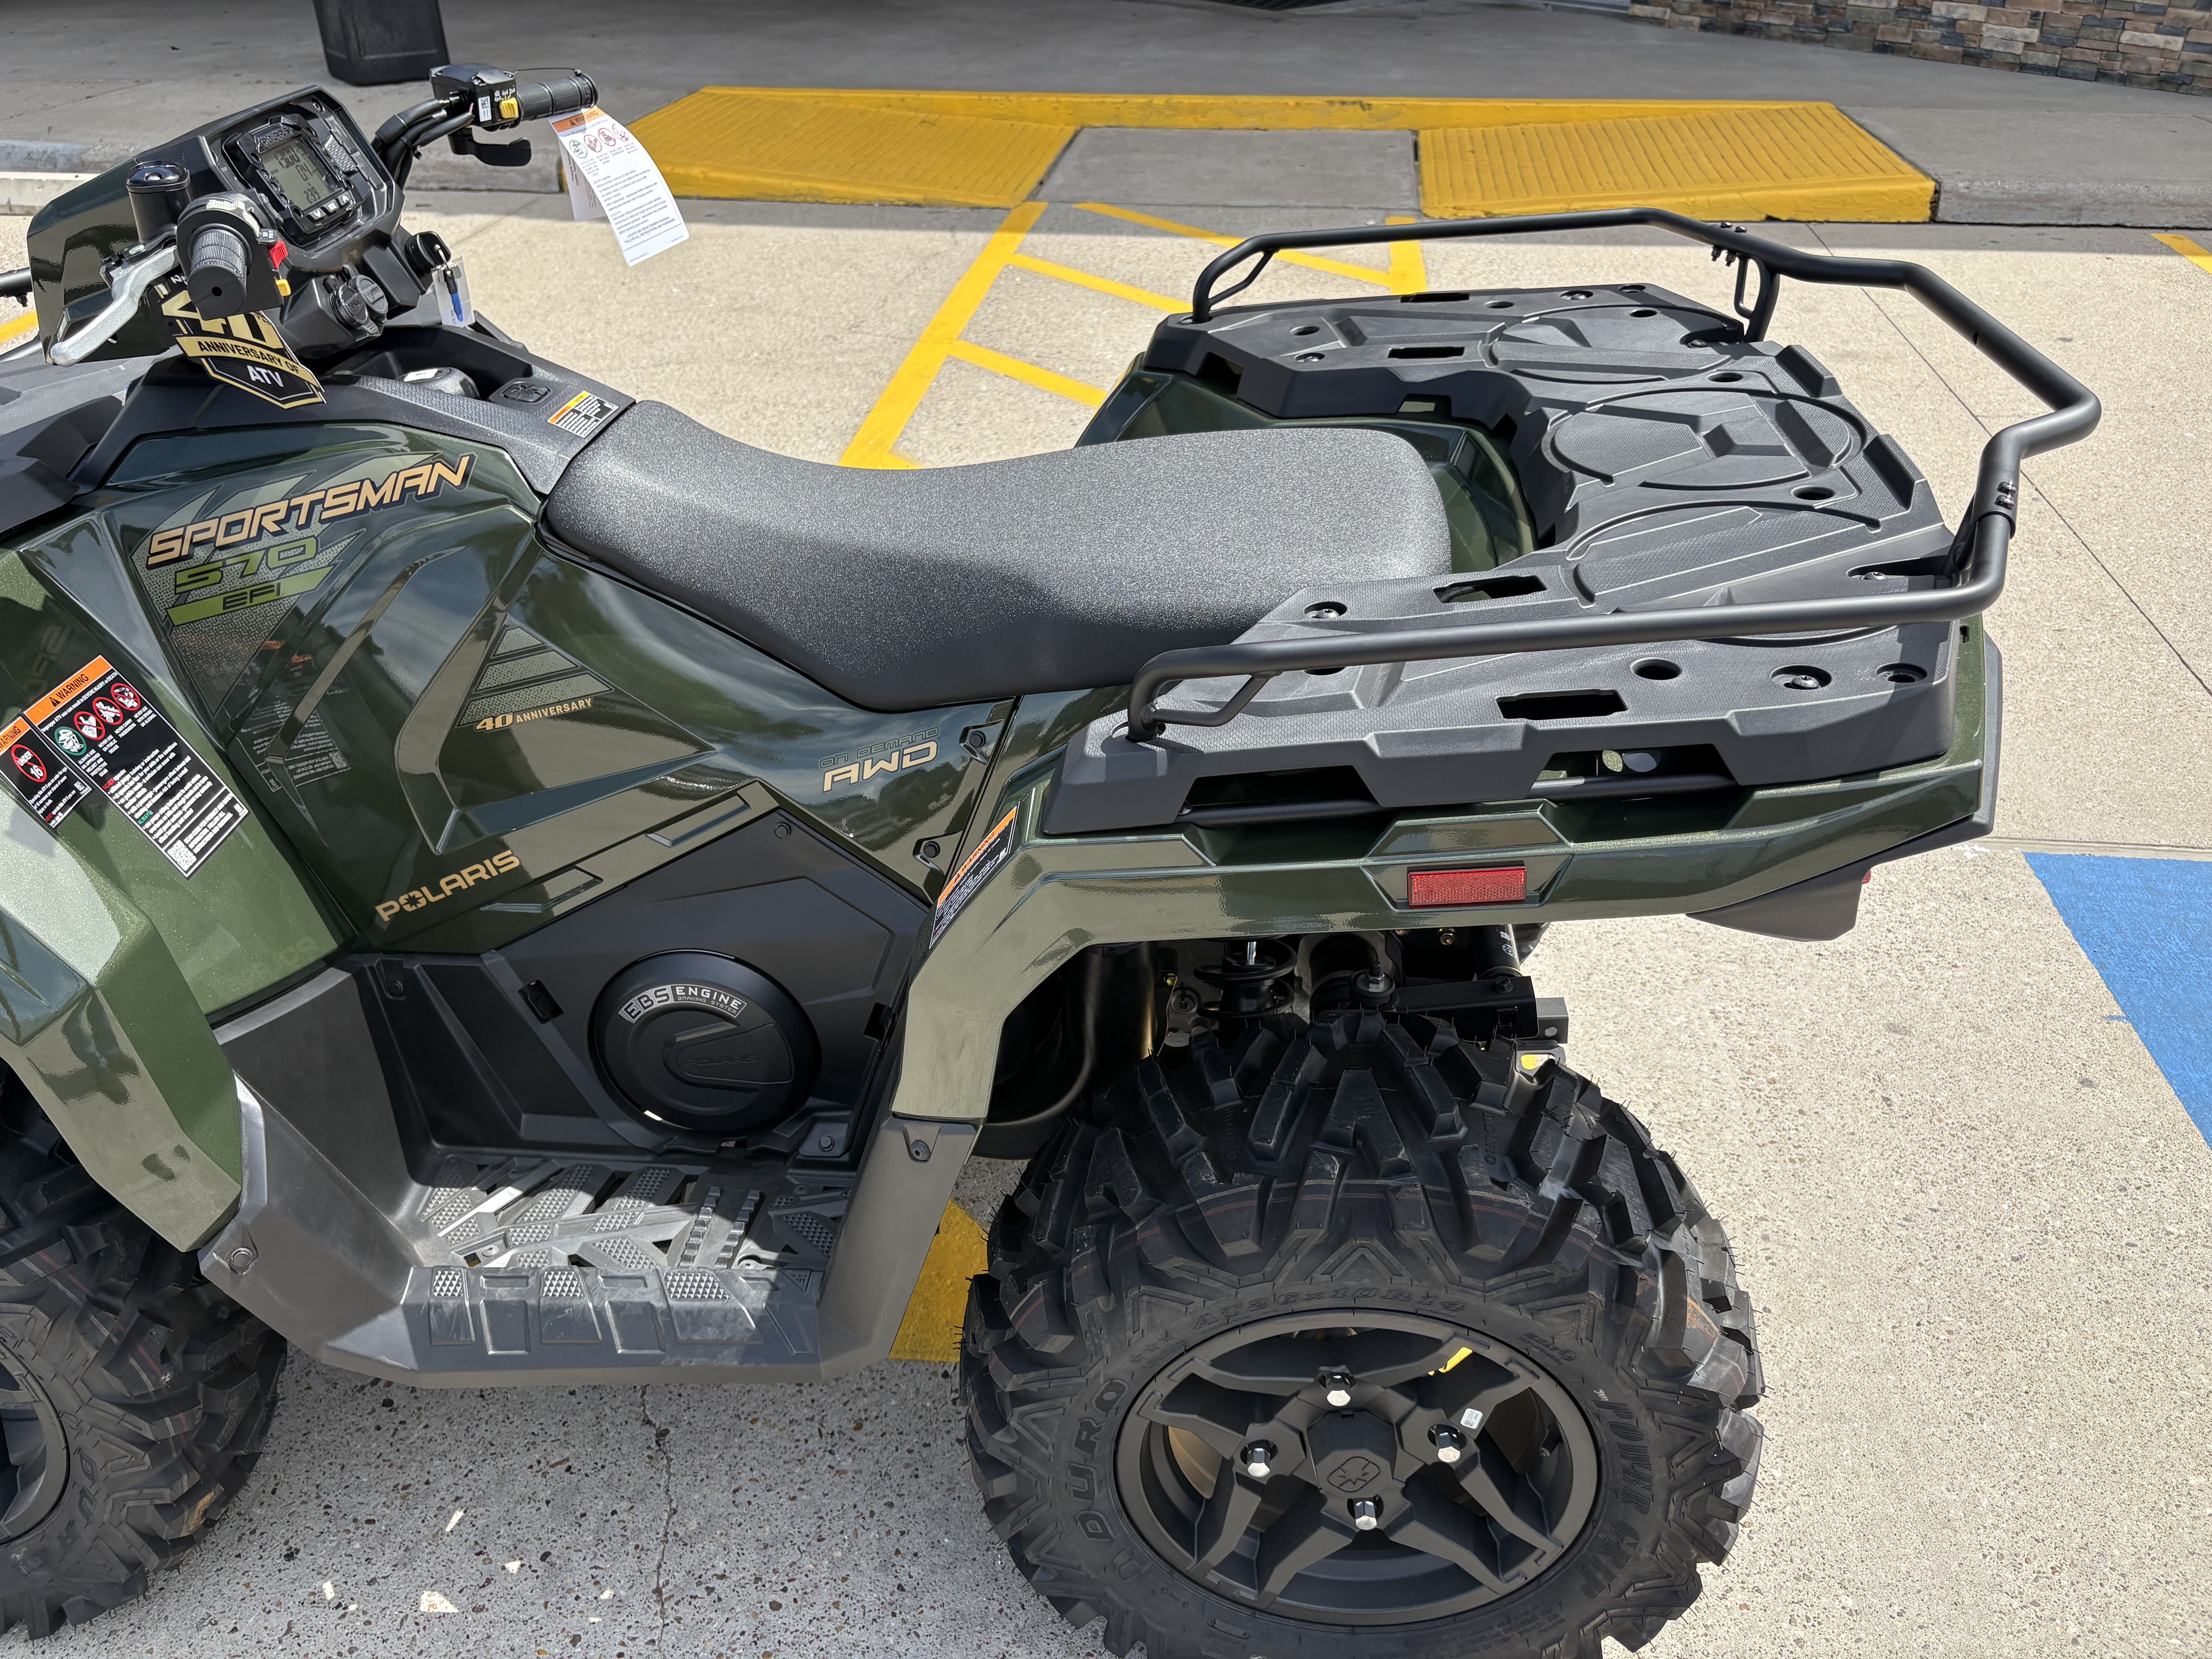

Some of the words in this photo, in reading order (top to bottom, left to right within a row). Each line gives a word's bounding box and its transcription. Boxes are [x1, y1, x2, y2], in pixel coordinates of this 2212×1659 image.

[198, 341, 283, 366] ANNIVERSARY
[287, 361, 299, 374] OF
[247, 365, 284, 387] ATV
[148, 455, 471, 565] SPORTSMAN
[175, 537, 318, 594] 570
[223, 581, 281, 611] EFI
[55, 673, 90, 701] WARNING
[106, 671, 118, 682] DEATH
[516, 698, 592, 723] ANNIVERSARY
[15, 750, 34, 767] UNDER
[820, 753, 849, 768] ON
[857, 727, 939, 758] DEMAND
[28, 764, 45, 780] 16
[823, 740, 938, 793] AWD
[962, 831, 996, 872] WARNING
[375, 850, 521, 922] POLARIS
[623, 985, 671, 1020] EBS
[675, 986, 742, 1010] ENGINE
[711, 1000, 737, 1014] SYSTEM
[685, 1054, 759, 1068] POLARIS
[1071, 1378, 1132, 1542] DURO
